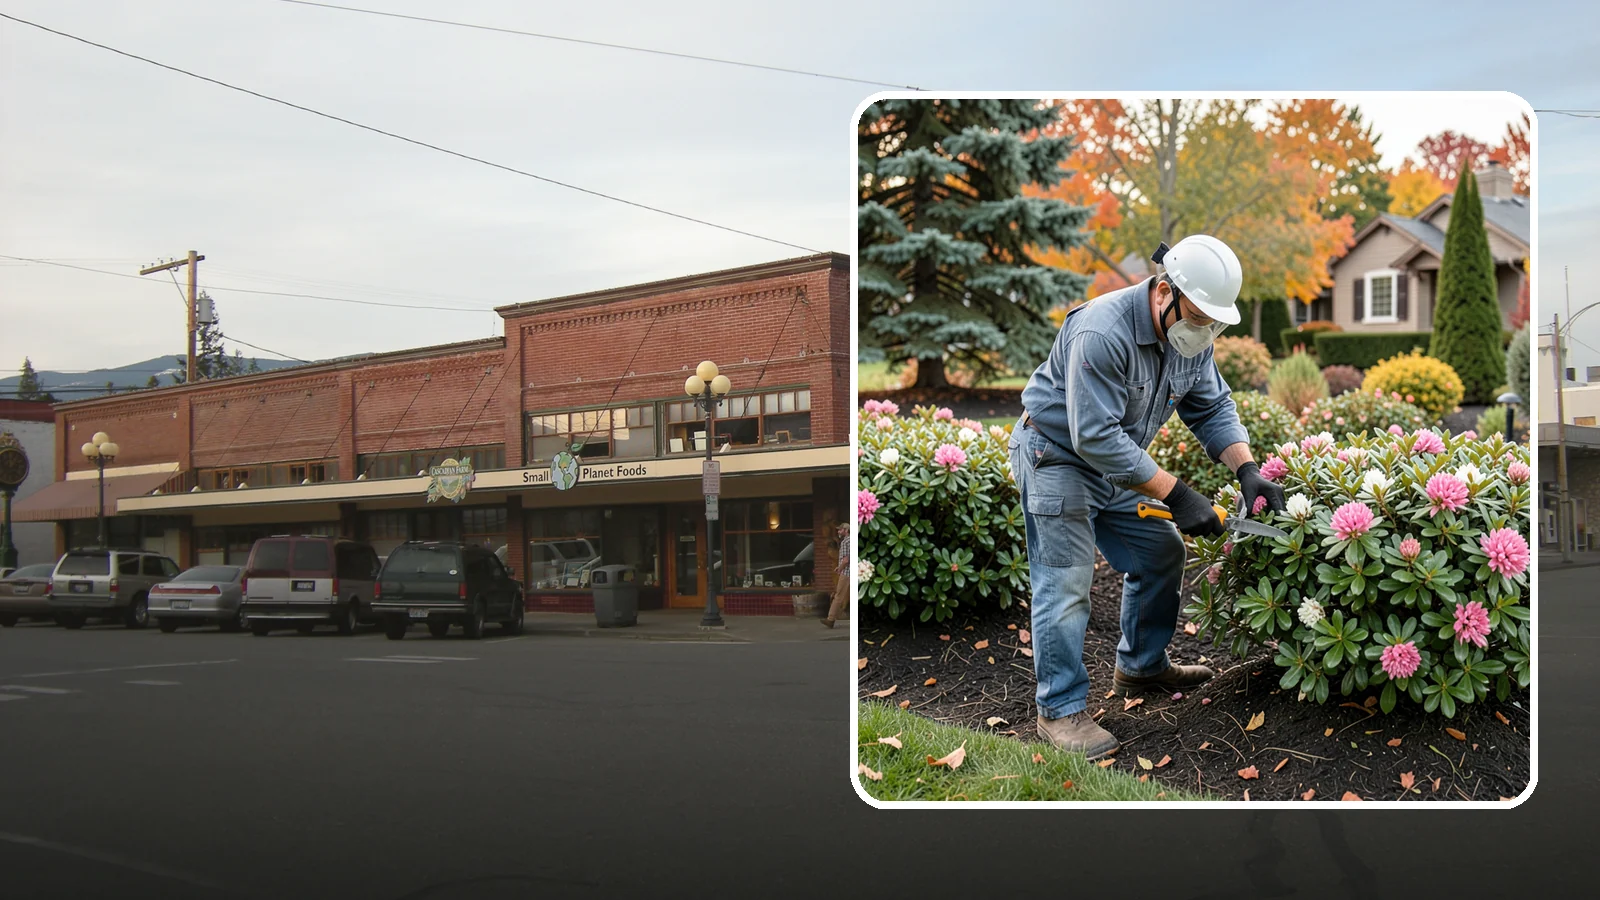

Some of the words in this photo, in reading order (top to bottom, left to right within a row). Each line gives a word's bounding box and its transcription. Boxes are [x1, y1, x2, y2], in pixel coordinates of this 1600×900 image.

[523, 471, 549, 483] Small
[583, 467, 614, 479] Planet
[617, 464, 647, 477] Foods
